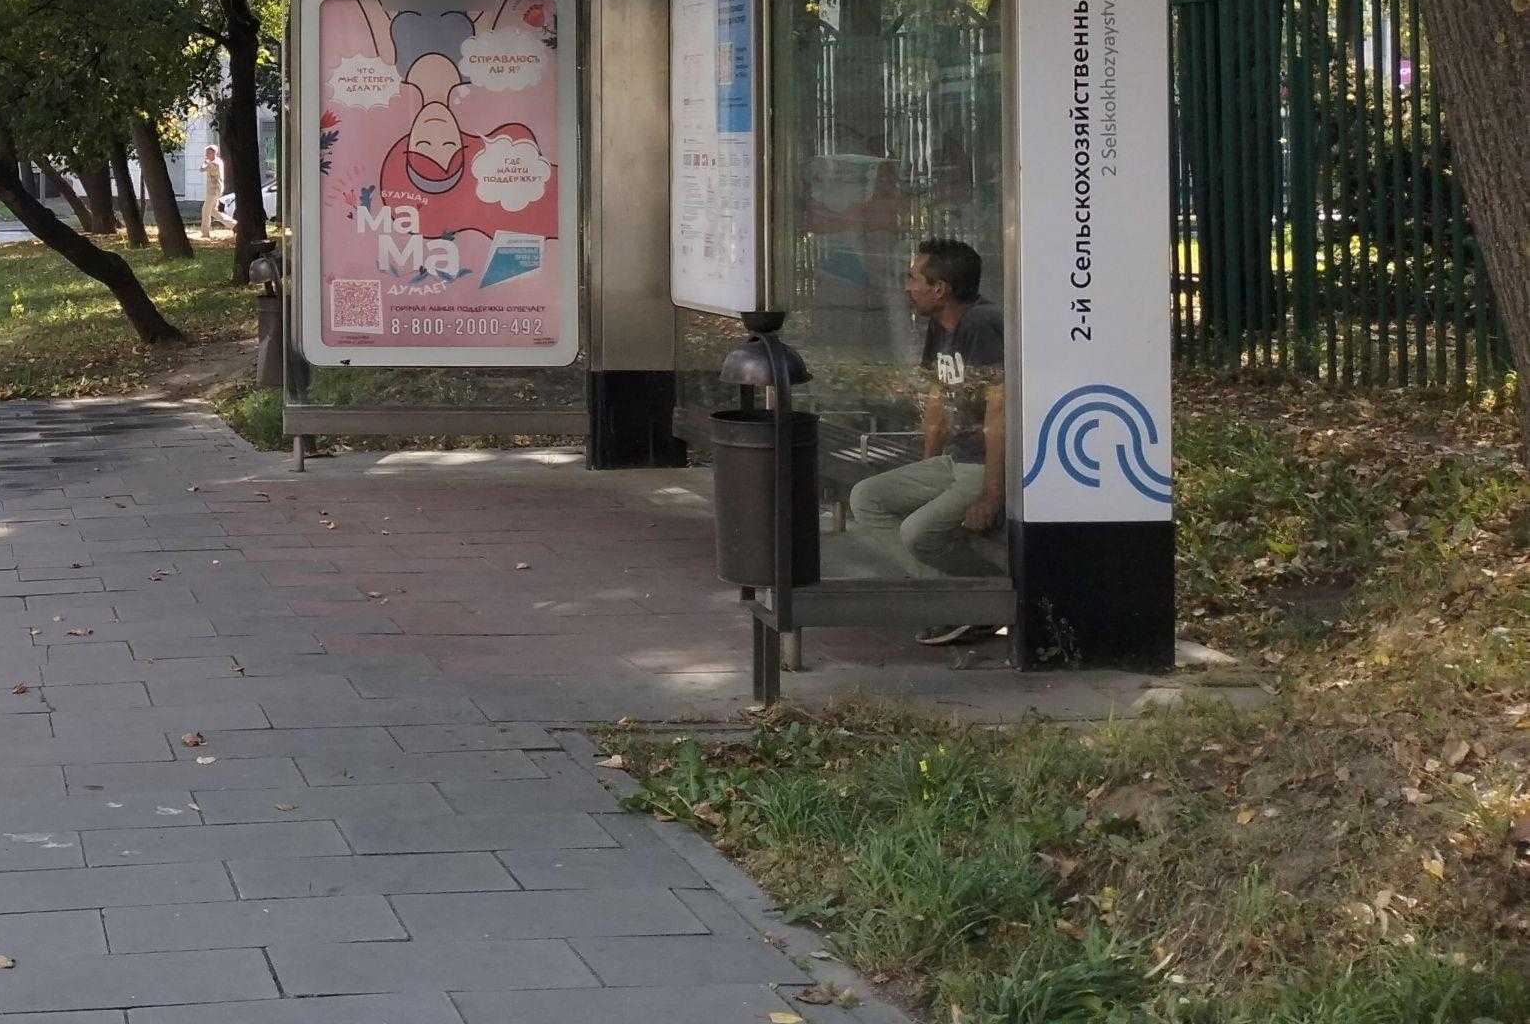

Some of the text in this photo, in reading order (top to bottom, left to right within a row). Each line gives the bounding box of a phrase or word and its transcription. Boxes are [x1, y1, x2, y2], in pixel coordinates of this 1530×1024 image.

[1100, 165, 1117, 177] 2
[391, 318, 543, 335] 8-800-2000-492
[1070, 298, 1092, 342] 2-й
